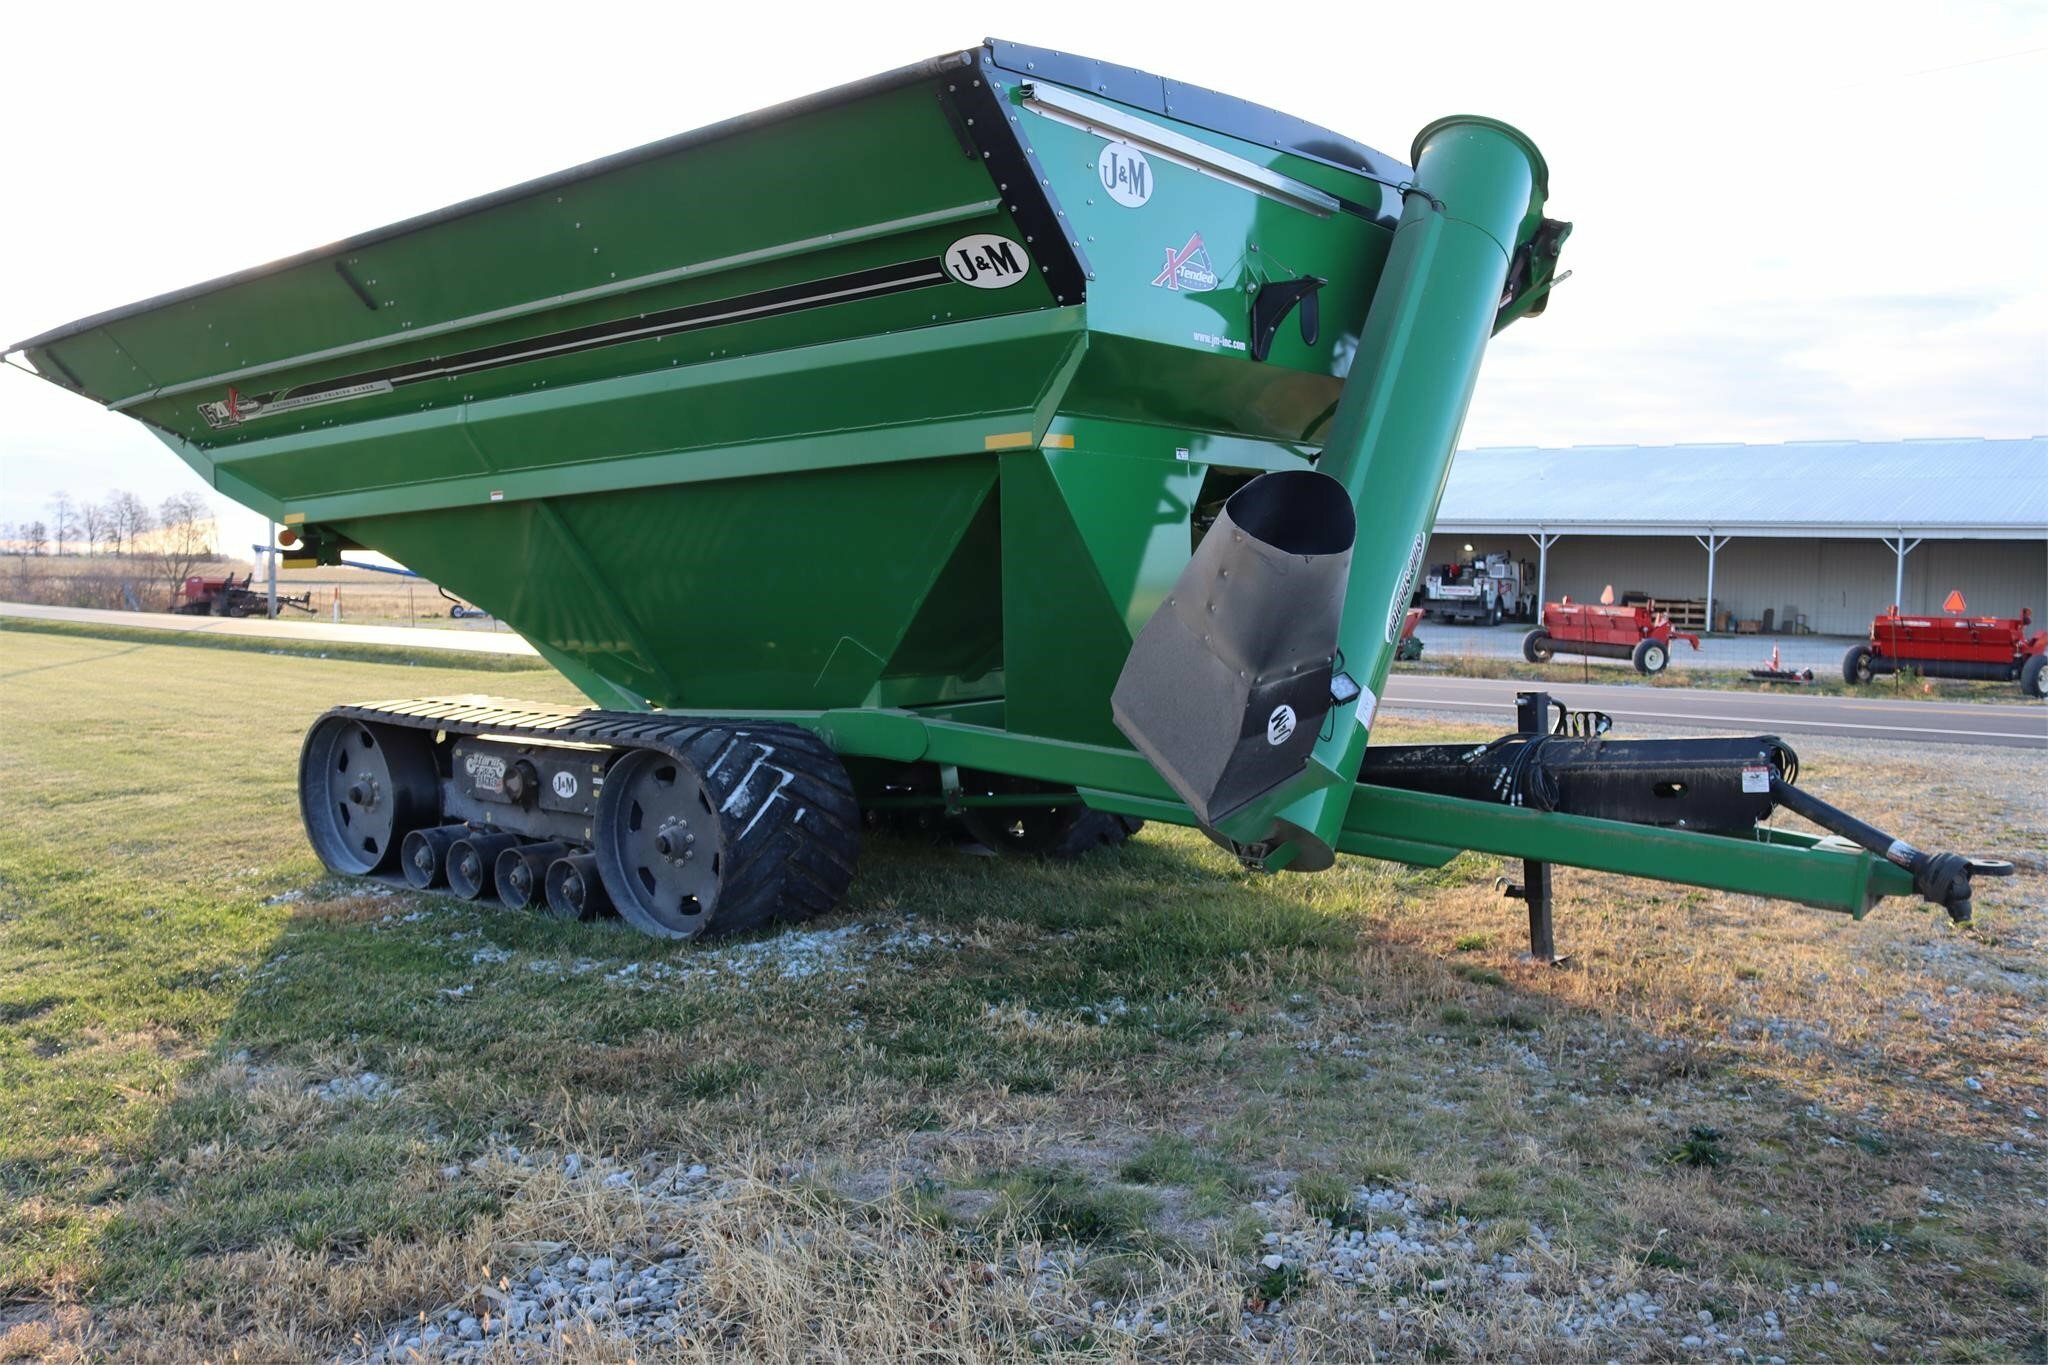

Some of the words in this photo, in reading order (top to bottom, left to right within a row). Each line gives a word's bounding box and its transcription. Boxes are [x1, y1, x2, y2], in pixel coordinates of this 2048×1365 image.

[1103, 152, 1146, 199] J&M
[953, 242, 1023, 281] J&M
[1270, 706, 1291, 742] J&M
[554, 775, 574, 793] J&M
